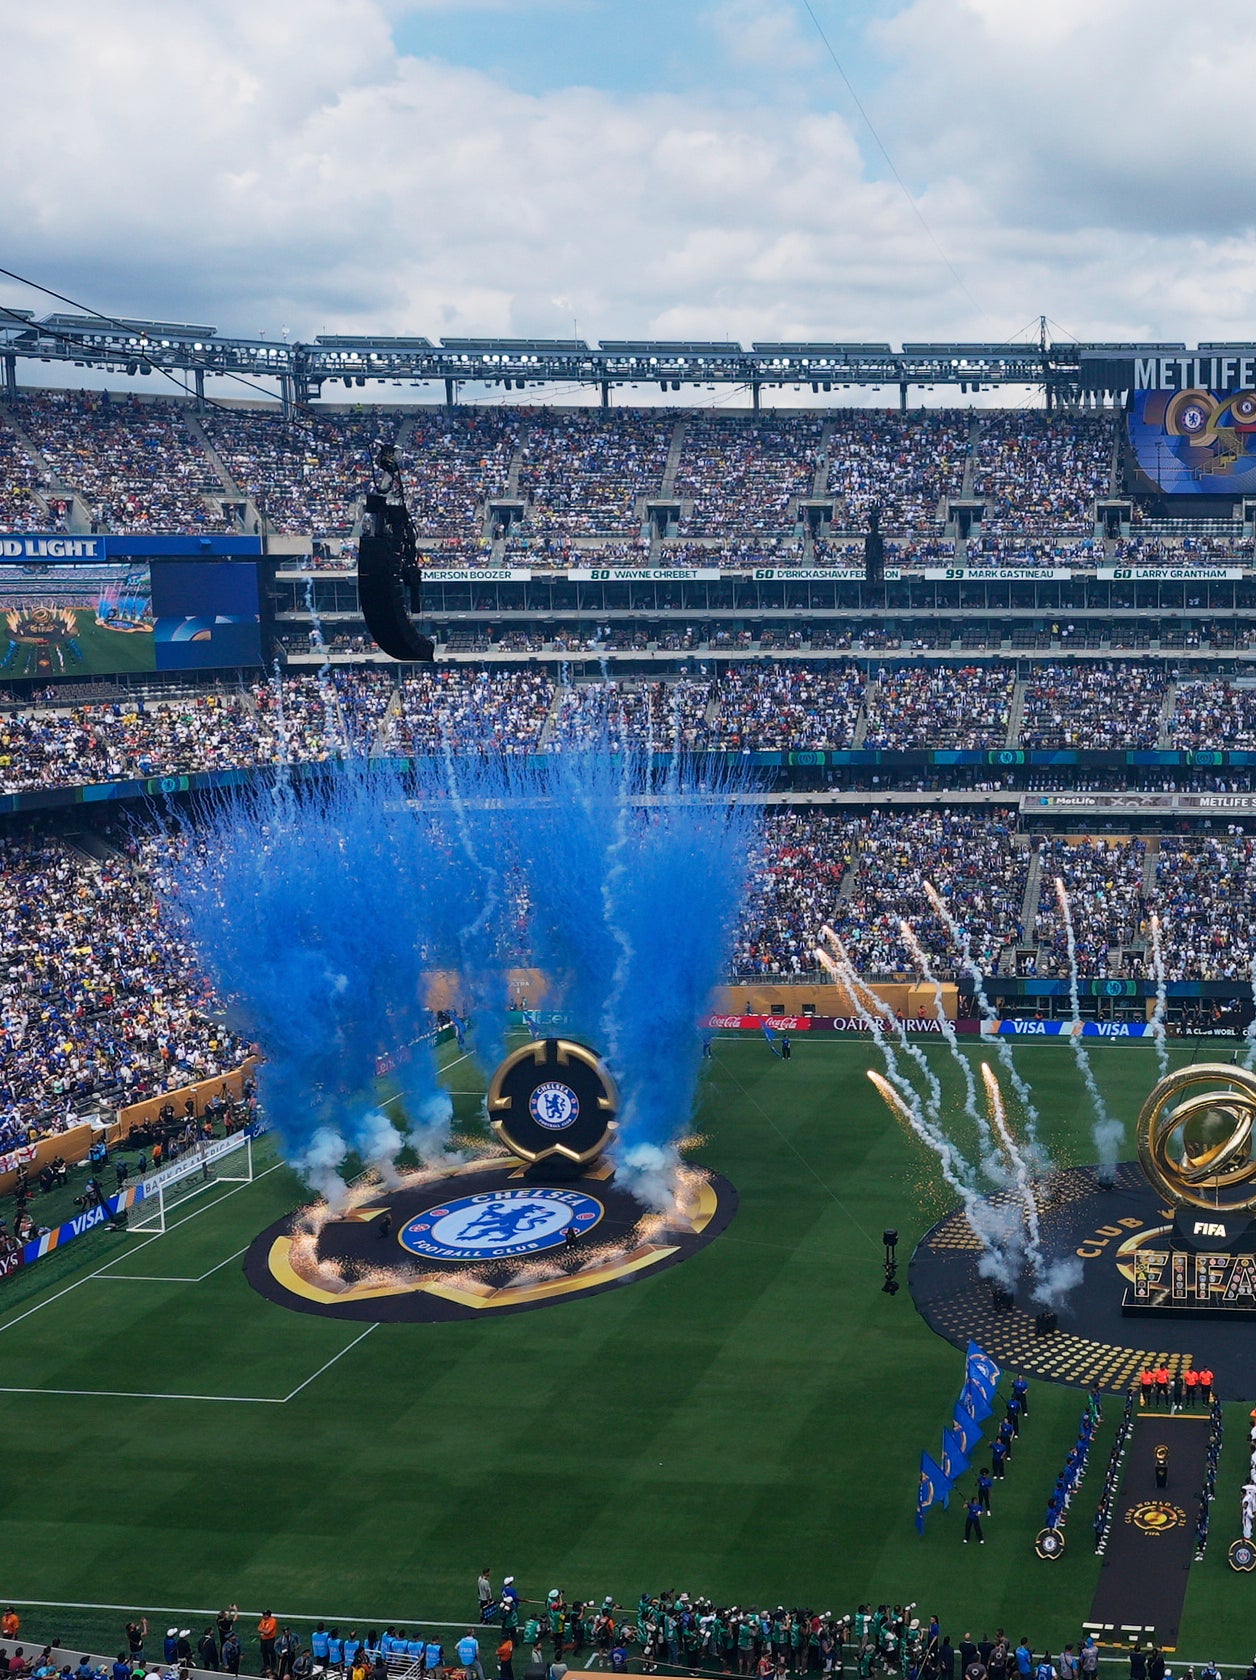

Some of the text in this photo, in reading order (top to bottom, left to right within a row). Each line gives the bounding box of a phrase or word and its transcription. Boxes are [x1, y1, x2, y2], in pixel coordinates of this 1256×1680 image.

[1134, 357, 1256, 391] METLIFE
[25, 539, 98, 557] LIGHT
[422, 570, 512, 580] MERSON BOOZER
[590, 570, 698, 580] 80 WAYNE CHREBET
[755, 569, 899, 579] 60 D'BRICKASHAW FERON
[945, 569, 1054, 579] 99 MARK GASTINEAU
[1113, 569, 1227, 579] 60 LARRY GRANTHAM
[1200, 797, 1249, 807] METLIFE
[1012, 1021, 1046, 1034] VISA
[1096, 1023, 1130, 1036] VISA
[536, 1083, 569, 1095] CHELSEA
[471, 1189, 588, 1214] CHELSEA
[69, 1208, 104, 1236] VISA
[1193, 1221, 1227, 1238] FIFA
[1076, 1217, 1144, 1258] CLUB
[413, 1239, 539, 1257] FOOTBALL CLUB
